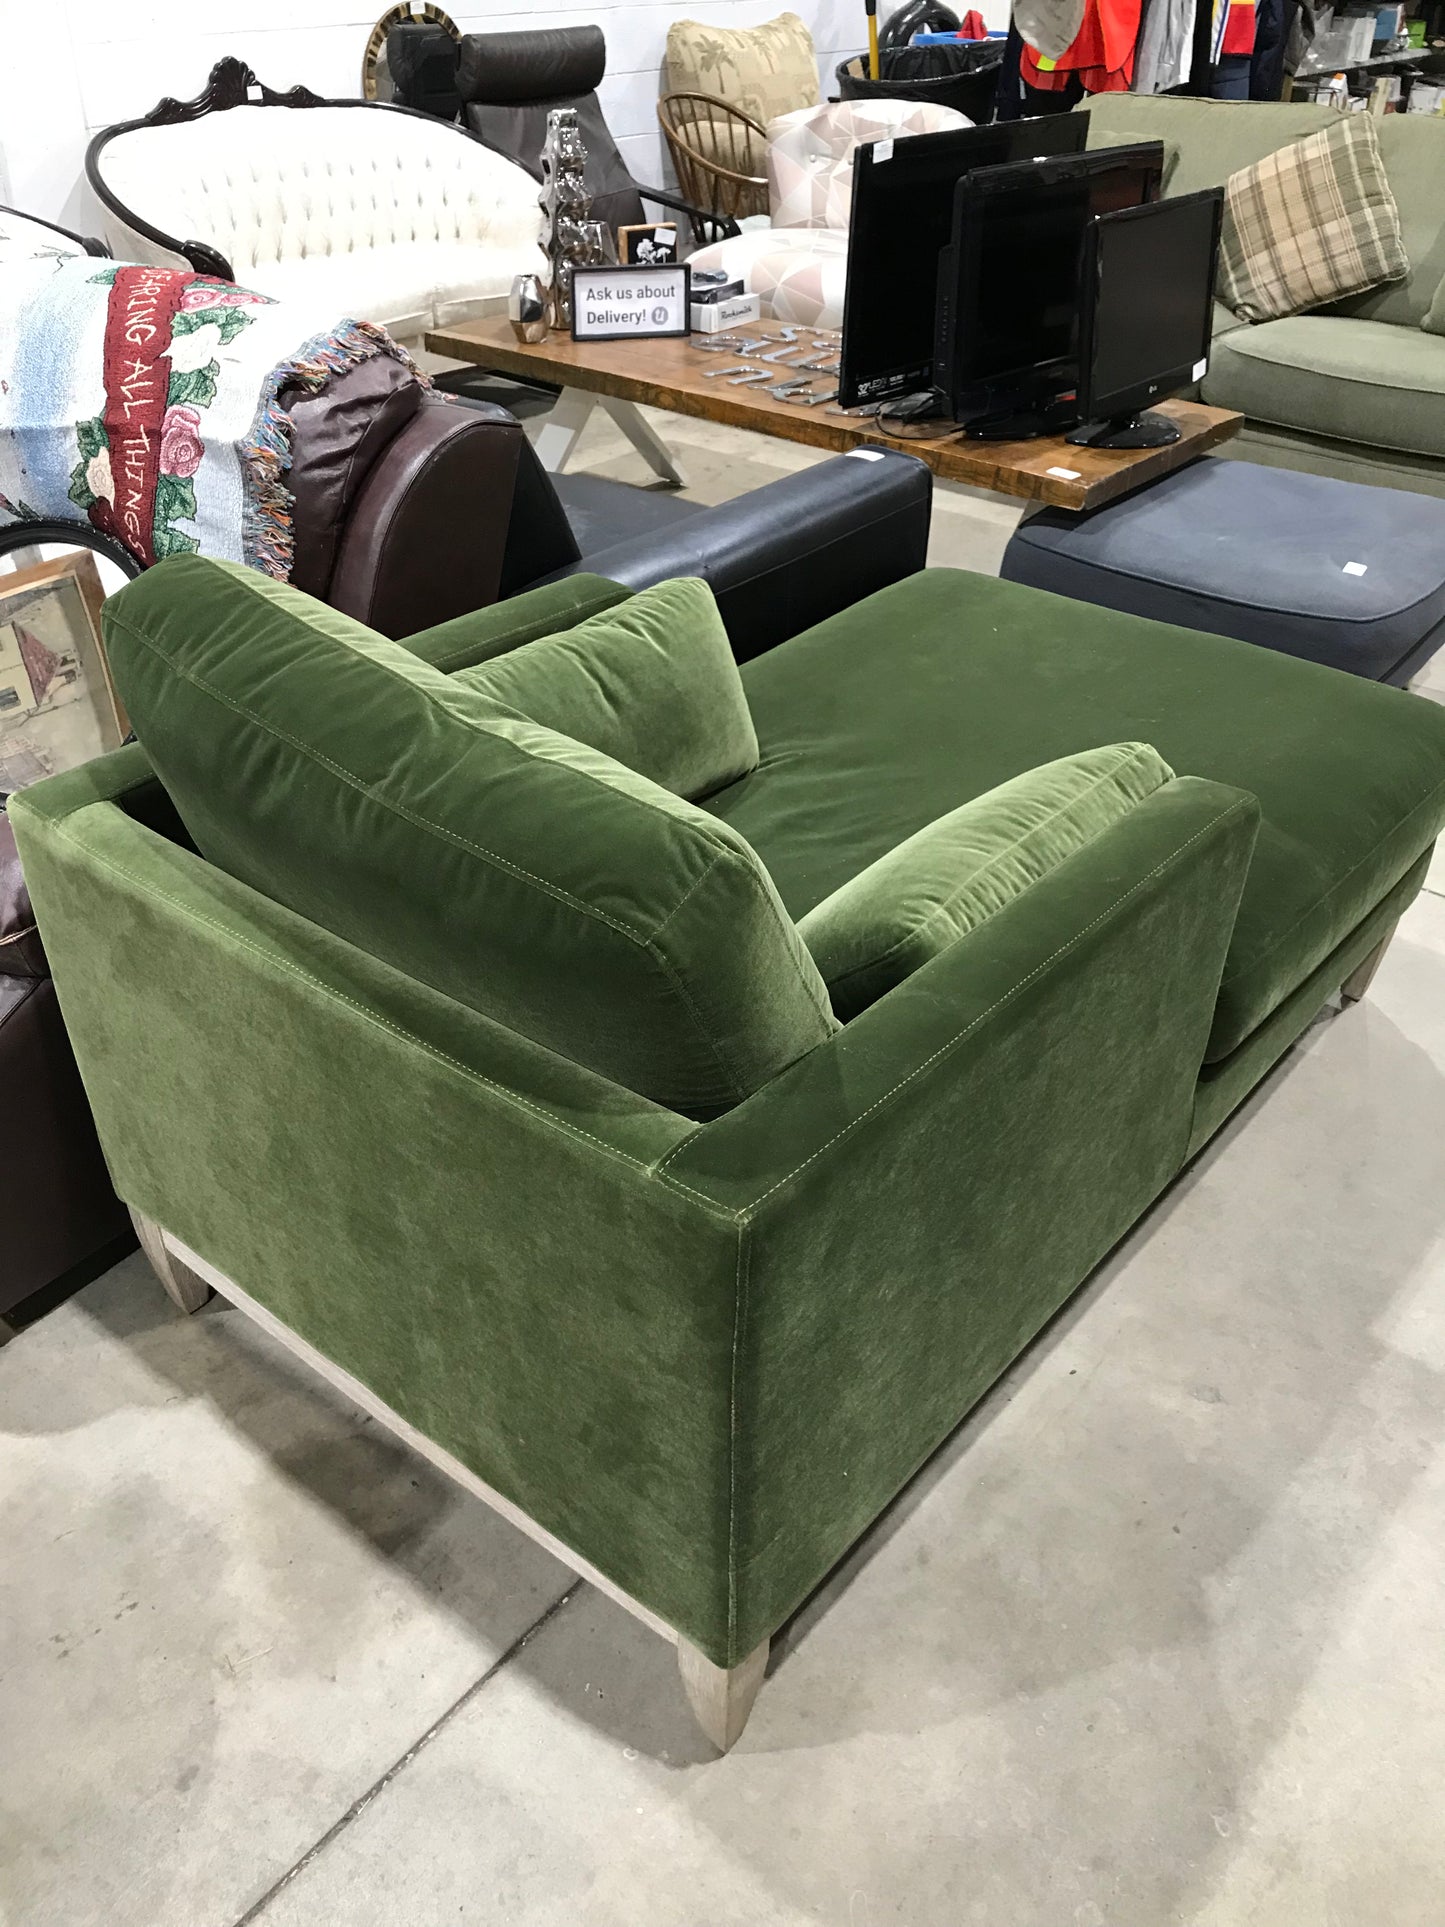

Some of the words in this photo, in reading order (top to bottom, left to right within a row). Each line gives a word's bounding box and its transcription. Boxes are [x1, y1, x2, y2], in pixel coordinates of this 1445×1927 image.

[586, 286, 613, 301] Ask
[616, 288, 633, 300] us
[636, 284, 676, 299] about
[587, 308, 647, 326] Delivery!
[120, 357, 154, 420] ALL
[122, 424, 151, 559] THINGS
